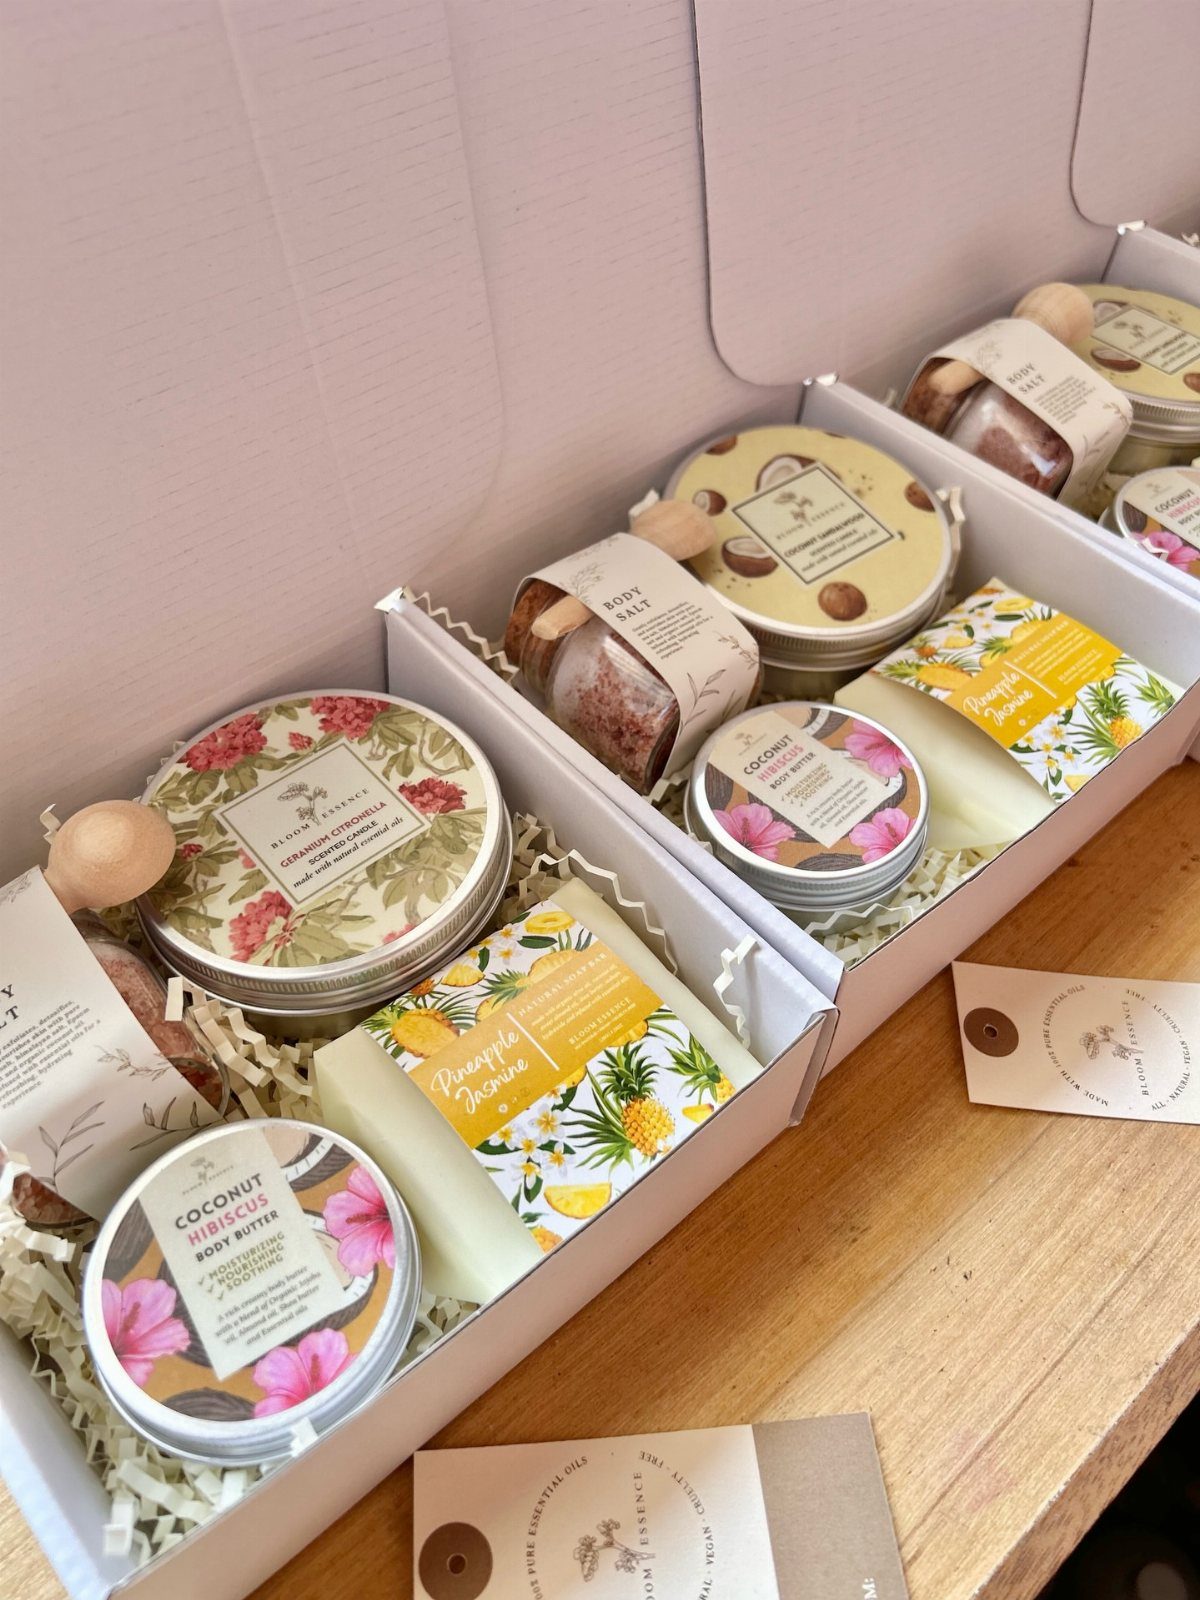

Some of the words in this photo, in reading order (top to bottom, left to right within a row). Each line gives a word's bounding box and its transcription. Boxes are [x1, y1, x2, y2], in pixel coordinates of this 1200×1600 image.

[1006, 363, 1035, 384] BODY
[1018, 373, 1046, 394] SALT
[1155, 488, 1195, 513] COCONUT
[603, 586, 643, 612] BODY
[616, 599, 652, 622] SALT
[963, 670, 1020, 716] Pineapple
[984, 689, 1034, 727] Jasmine
[743, 734, 793, 775] COCONUT
[757, 744, 804, 782] HIBISCUS
[769, 772, 790, 790] BODY
[789, 752, 816, 773] BUTTER
[270, 823, 310, 849] BLOOM
[322, 788, 369, 819] ESSENCE
[280, 834, 331, 868] GERANIUM
[331, 801, 387, 837] CITRONELLA
[293, 873, 313, 888] made
[315, 860, 332, 875] with
[333, 842, 359, 863] natural
[360, 824, 390, 847] essential
[391, 816, 404, 828] oils
[308, 839, 346, 865] SCENTED
[346, 820, 378, 841] CANDLE
[518, 984, 563, 1017] NATURAL
[563, 966, 587, 984] SOAP
[587, 952, 608, 967] BAR
[1067, 984, 1085, 995] OILS
[1043, 992, 1068, 1026] ESSENTIAL
[1121, 1000, 1138, 1045] ESSENCE
[1152, 1004, 1180, 1034] CRUELTY
[1042, 1028, 1052, 1049] PURE
[1180, 1040, 1191, 1064] VEGAN
[430, 1027, 520, 1097] Pineapple
[1060, 1070, 1080, 1091] WITH
[1134, 1058, 1149, 1096] BLOOM
[454, 1057, 529, 1115] Jasmine
[1084, 1089, 1109, 1107] MADE
[1169, 1072, 1191, 1101] NATURAL
[1151, 1101, 1166, 1112] ALL
[175, 1173, 262, 1230] COCONUT
[188, 1193, 269, 1246] HIBISCUS
[195, 1236, 230, 1262] BODY
[234, 1210, 279, 1240] BUTTER
[209, 1231, 285, 1280] MOISTURIZING
[217, 1243, 284, 1286] NOURISHING
[226, 1254, 284, 1291] SOOTHING
[564, 1456, 588, 1475] OILS
[639, 1450, 664, 1468] FREE
[528, 1474, 564, 1536] ESSENTIAL
[633, 1472, 649, 1546] ESSENCE
[671, 1471, 705, 1515] CRUELTY
[526, 1541, 536, 1575] PURE
[702, 1526, 714, 1565] VEGAN
